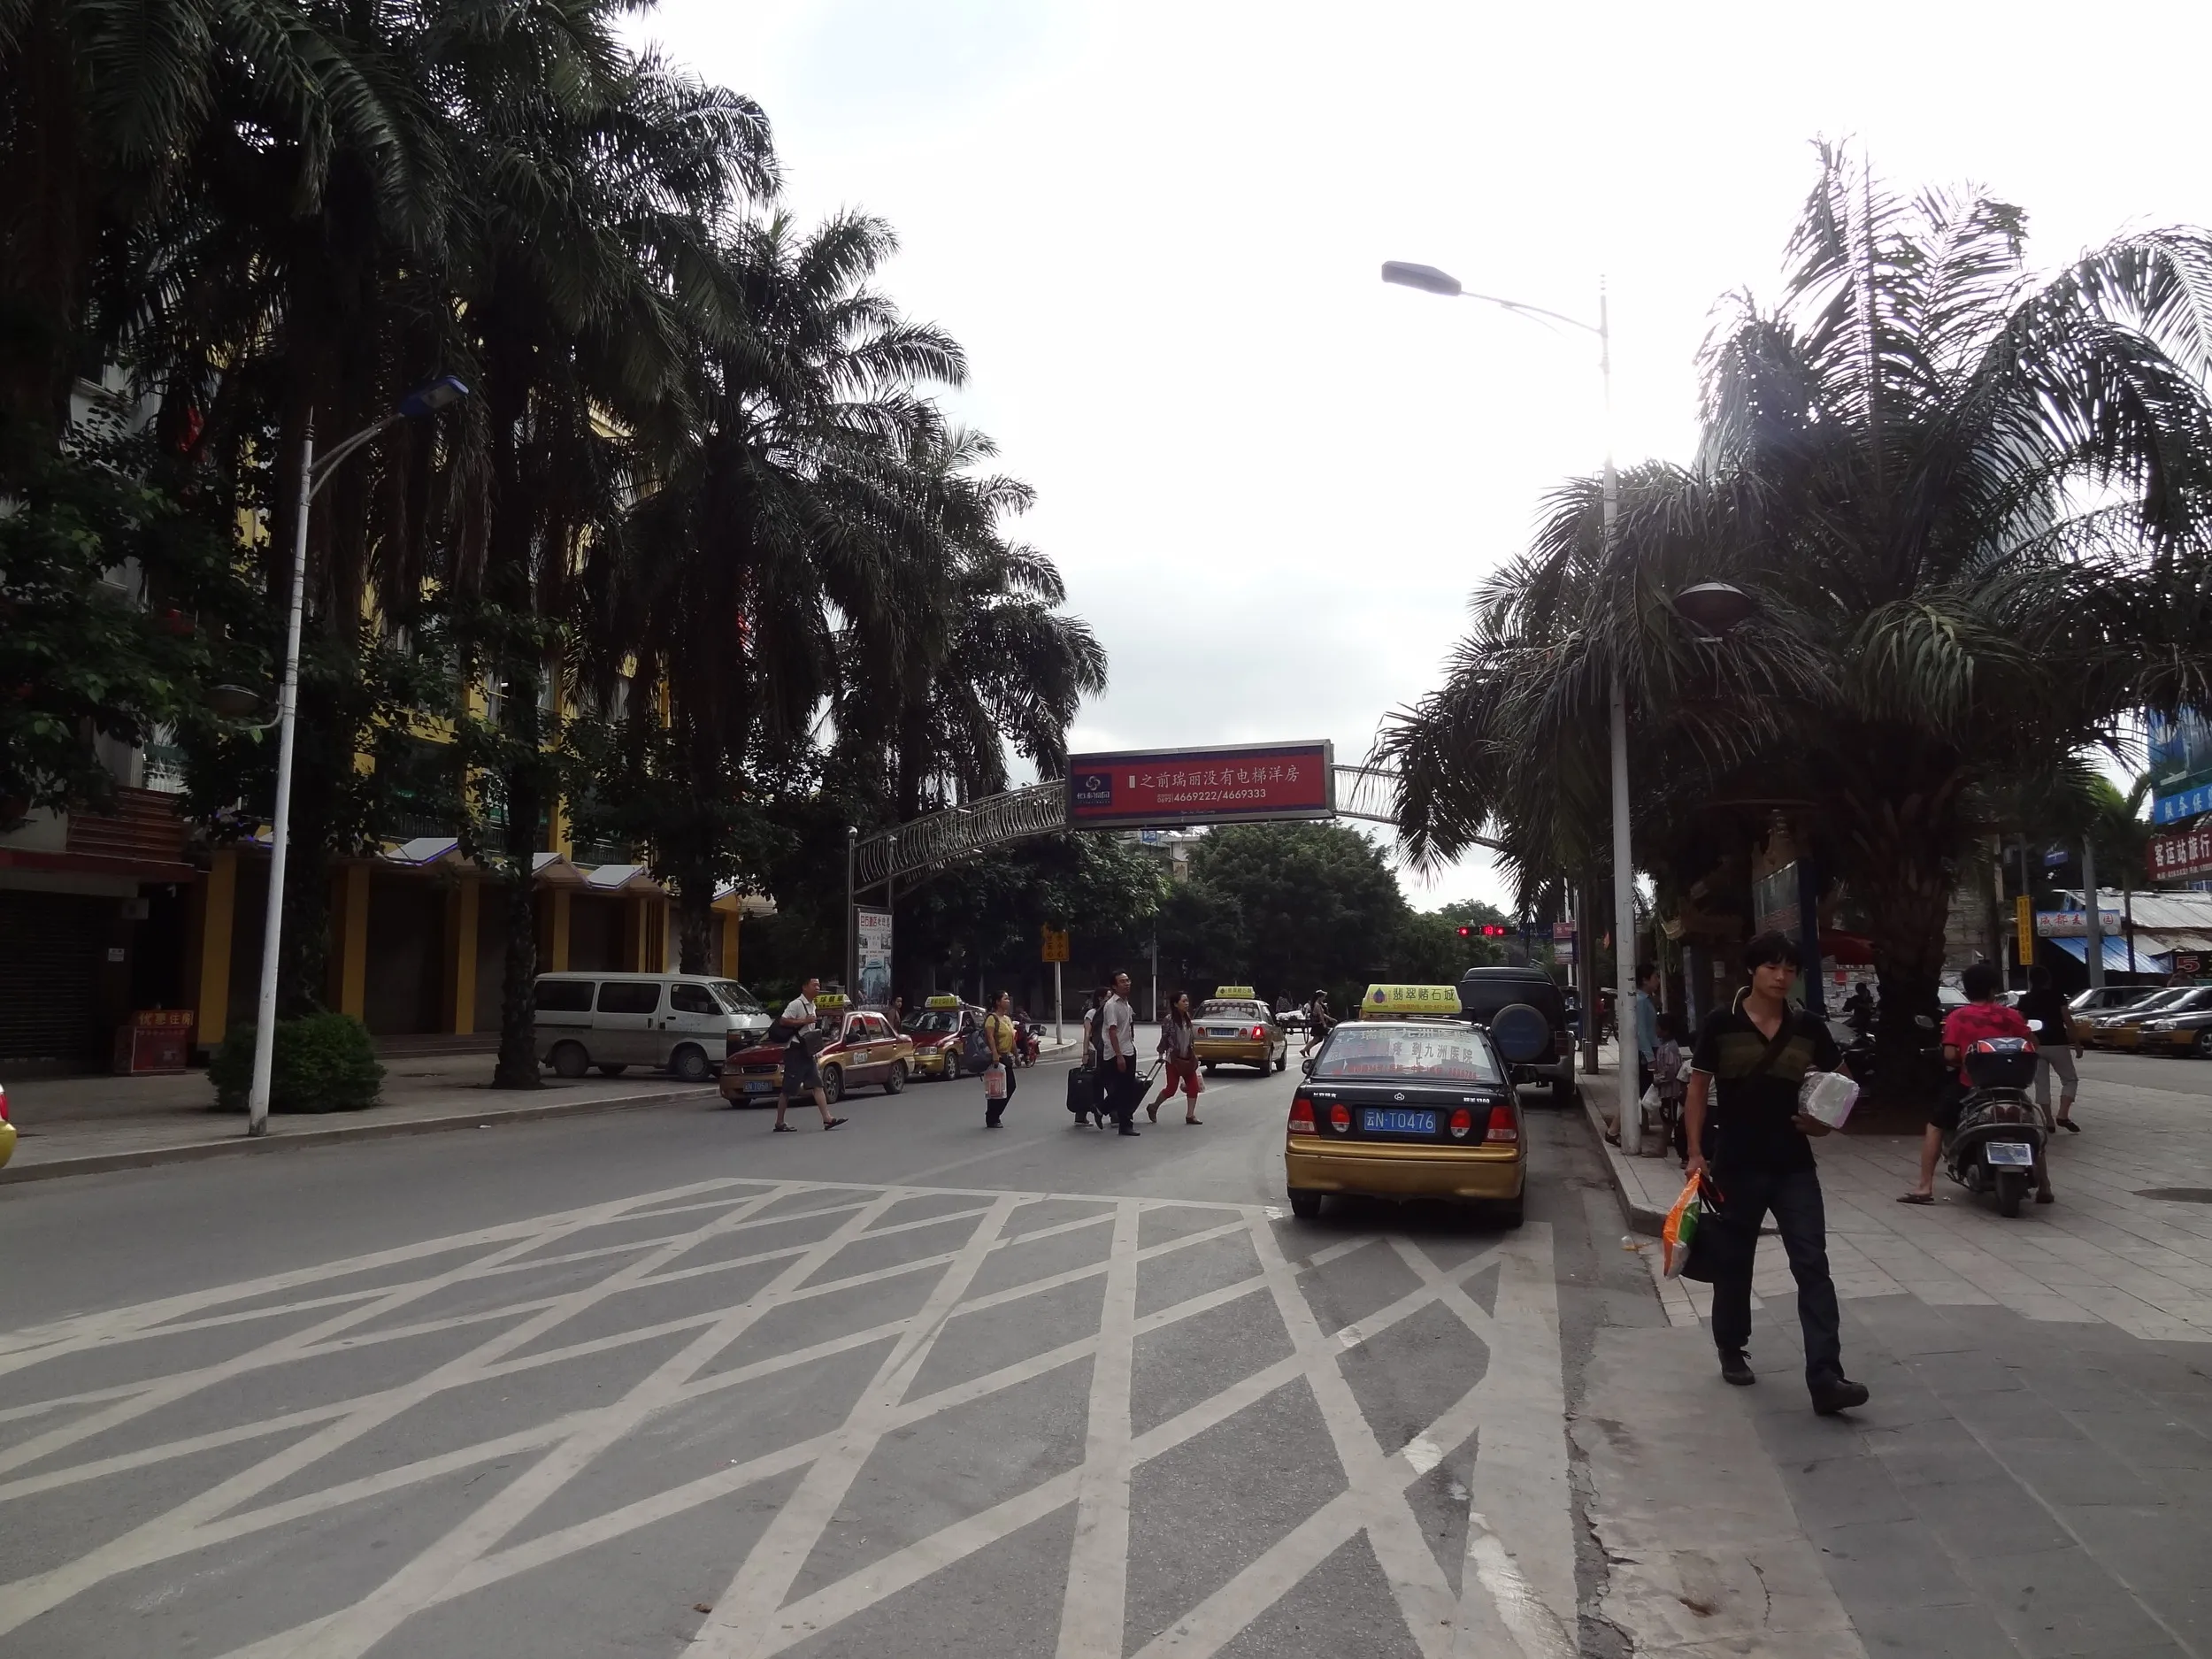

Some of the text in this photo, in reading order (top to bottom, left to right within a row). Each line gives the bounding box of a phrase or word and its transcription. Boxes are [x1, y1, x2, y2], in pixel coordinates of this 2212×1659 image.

[1140, 764, 1300, 788] 之前瑞丽没有电梯洋房
[1173, 788, 1267, 802] 4669222/4669333
[1393, 987, 1455, 1002] 翡翠赌石城
